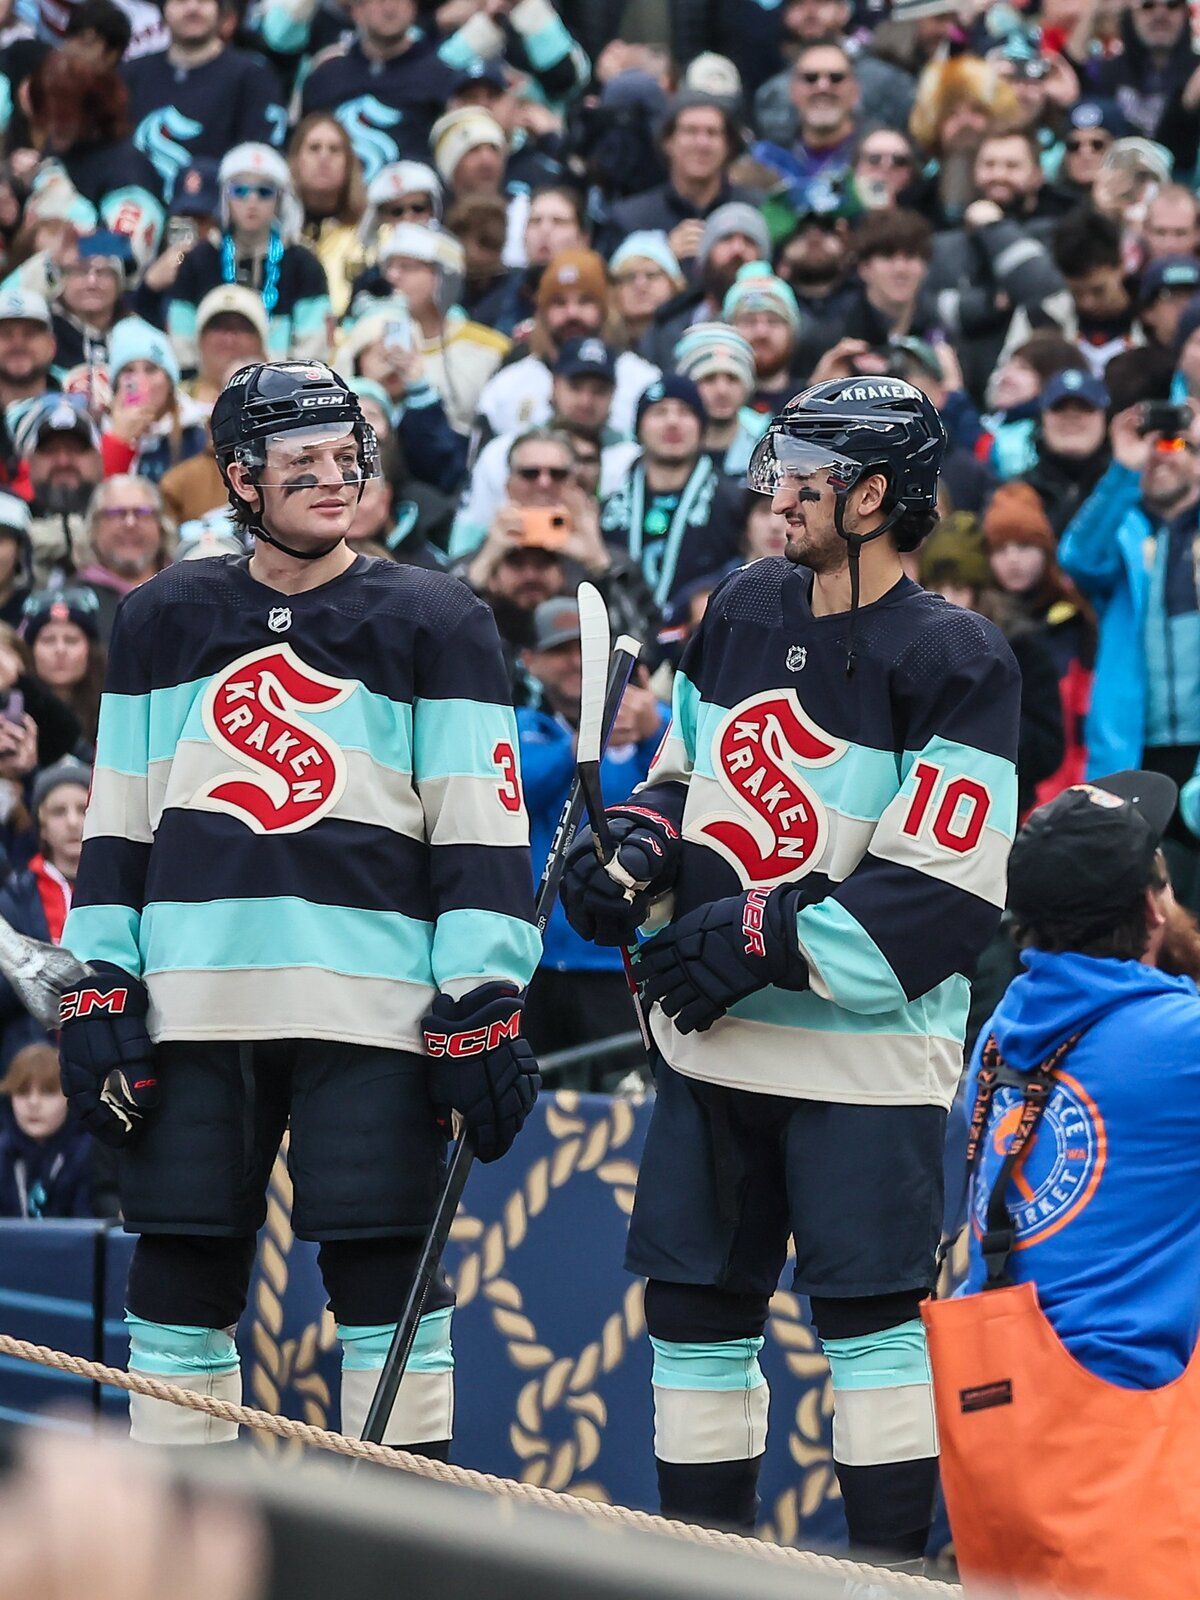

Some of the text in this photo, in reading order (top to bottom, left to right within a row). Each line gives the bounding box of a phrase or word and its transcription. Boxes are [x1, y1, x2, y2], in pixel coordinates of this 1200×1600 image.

[302, 396, 344, 407] CCM
[221, 680, 324, 804] KRAKEN
[491, 739, 524, 816] 3
[725, 720, 809, 859] KRAKEN
[898, 758, 993, 857] 10
[60, 988, 127, 1022] CM
[423, 1009, 521, 1058] CCM
